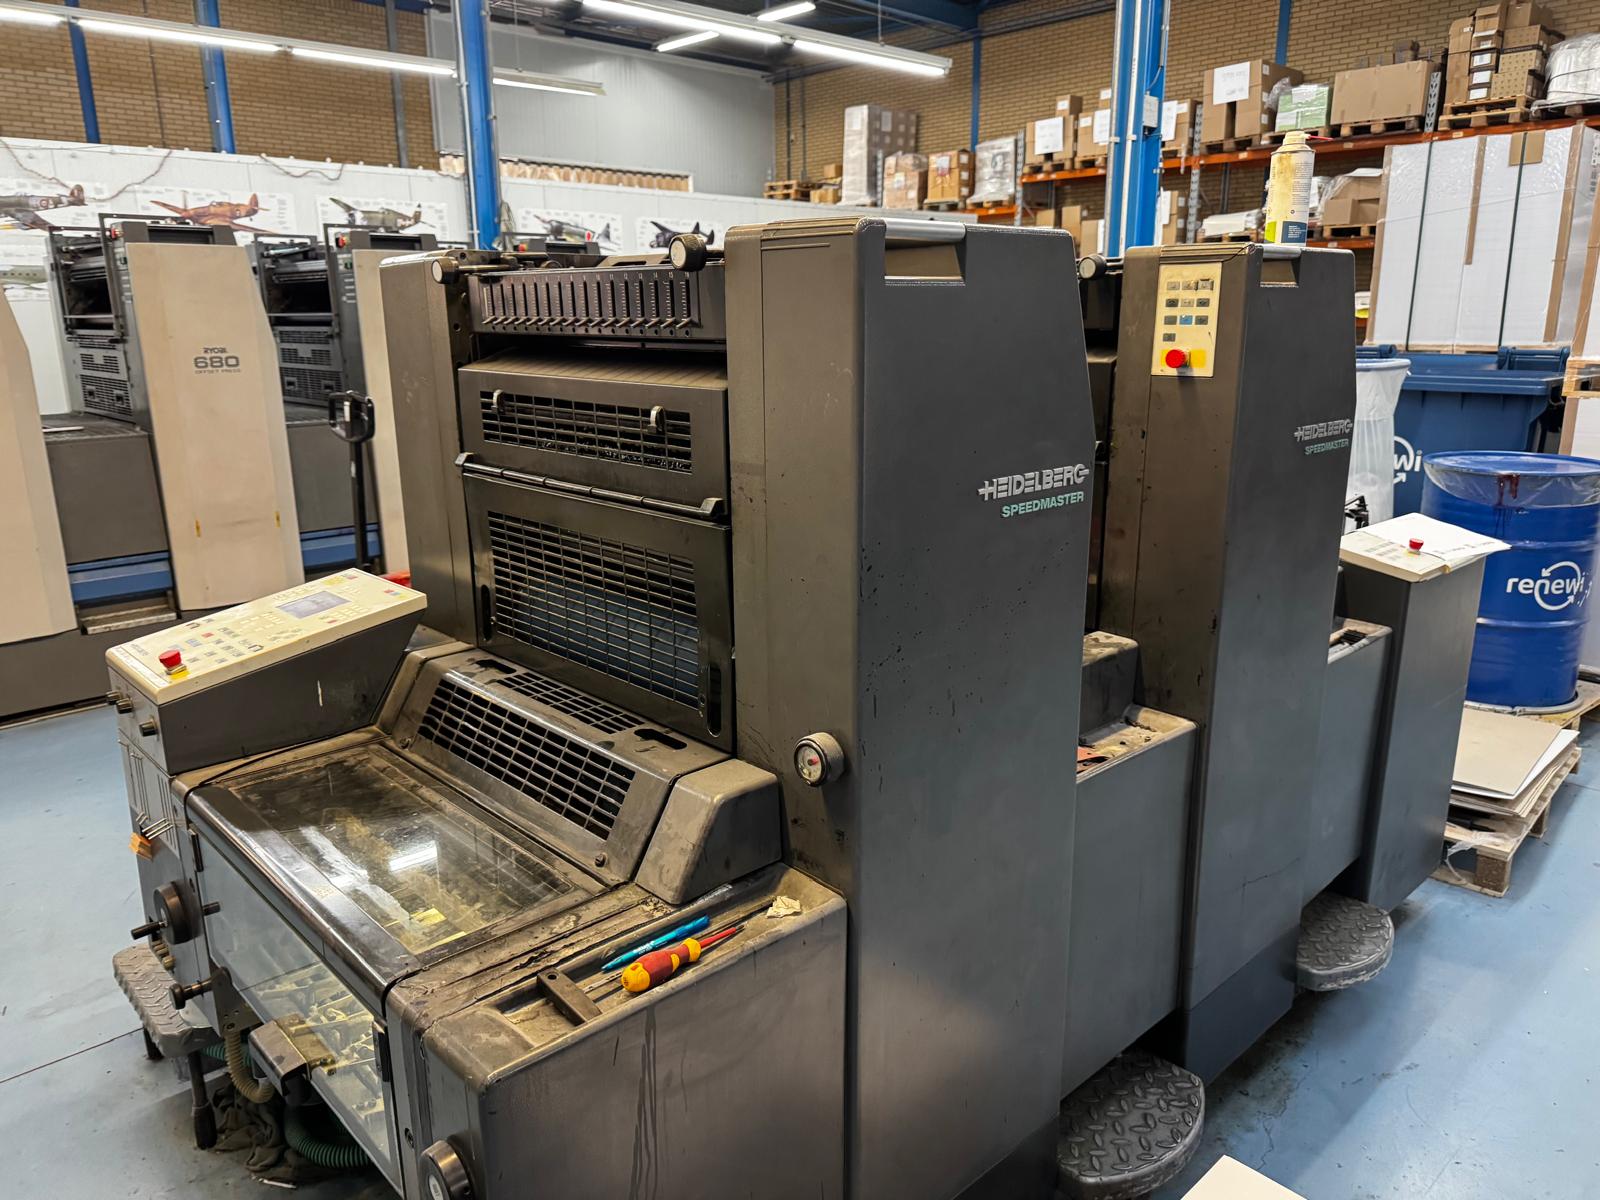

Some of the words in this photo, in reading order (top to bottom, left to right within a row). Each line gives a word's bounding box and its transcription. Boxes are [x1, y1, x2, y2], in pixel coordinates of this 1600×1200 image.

[194, 356, 240, 369] 680
[1294, 419, 1353, 442] HEIDELBERG
[1304, 438, 1349, 455] SPEEDMASTER
[978, 463, 1090, 501] HEIDELBERG
[1001, 491, 1085, 518] SPEEDMASTER
